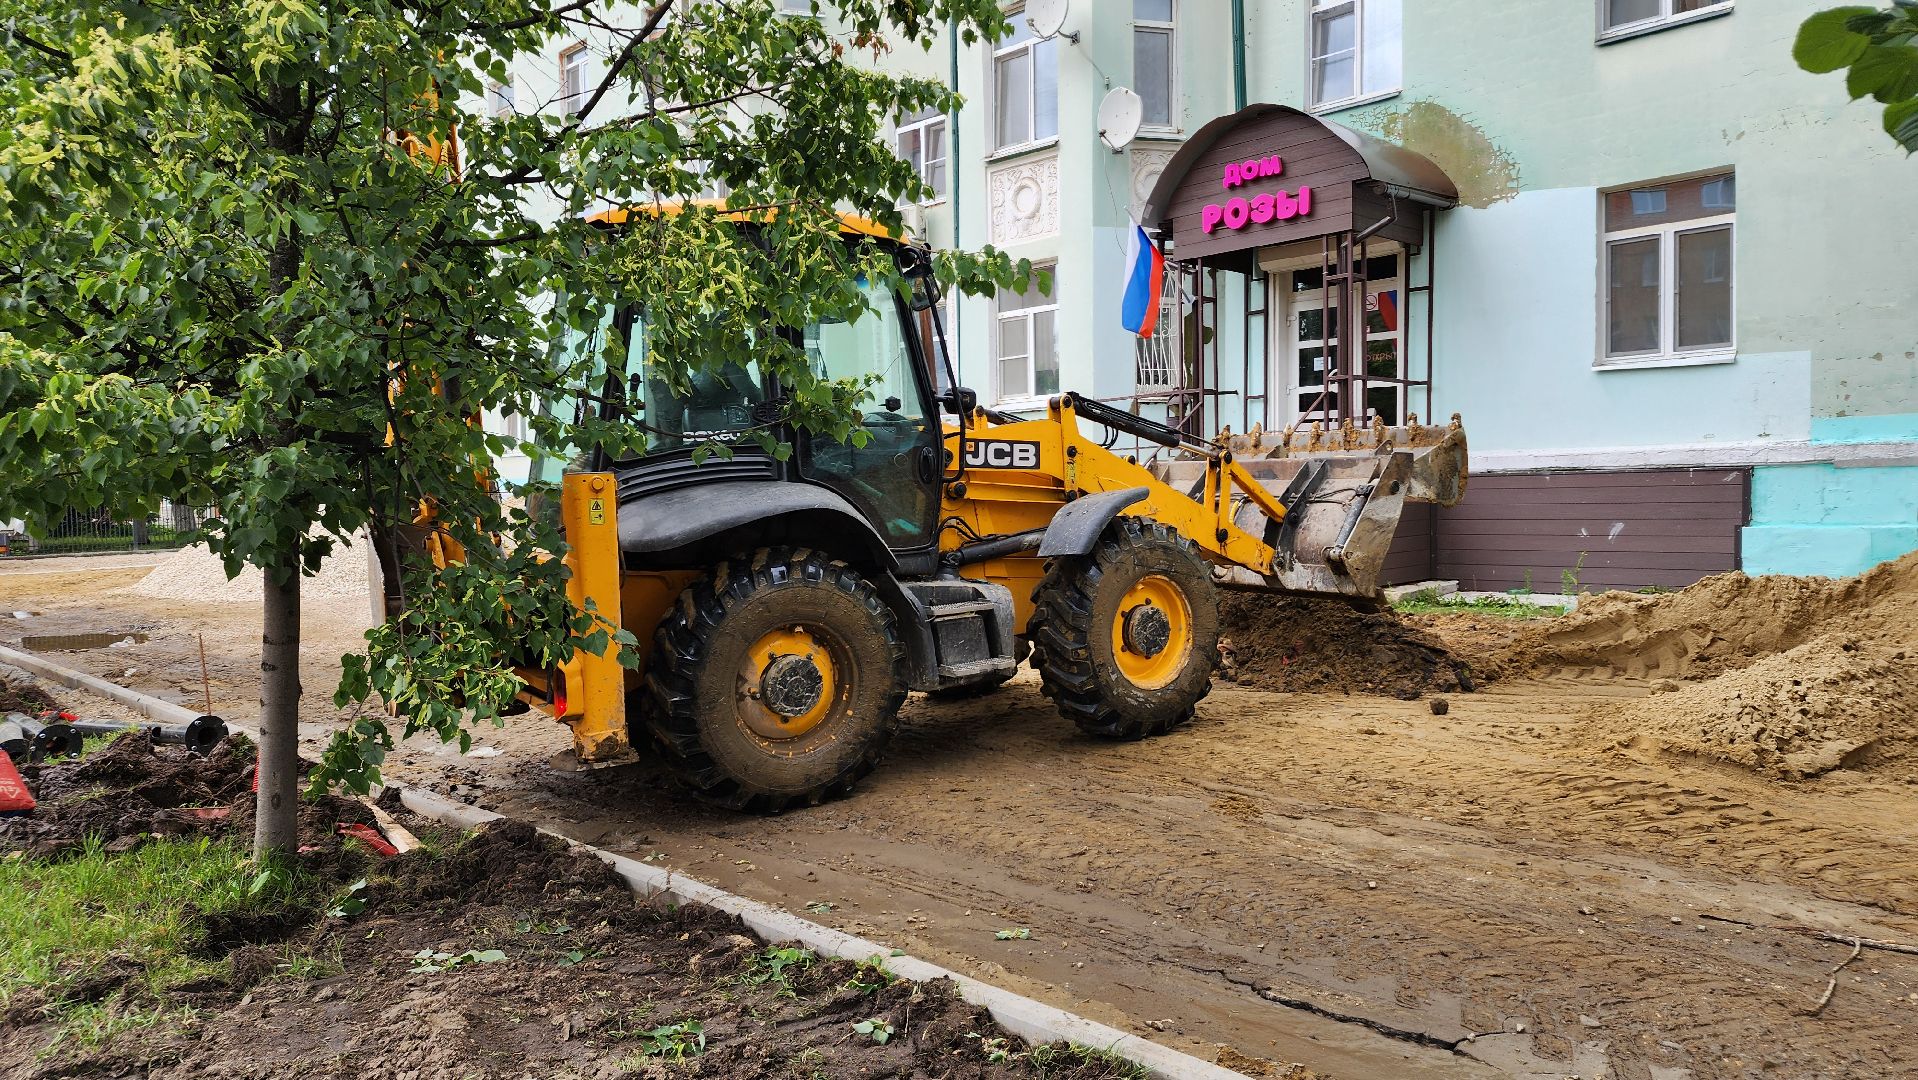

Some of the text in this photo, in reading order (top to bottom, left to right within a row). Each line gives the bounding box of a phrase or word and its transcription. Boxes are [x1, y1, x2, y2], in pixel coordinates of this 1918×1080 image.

[1222, 154, 1283, 189] ДОМ
[1201, 186, 1312, 234] РОЗЫ
[965, 441, 1037, 467] JCB
